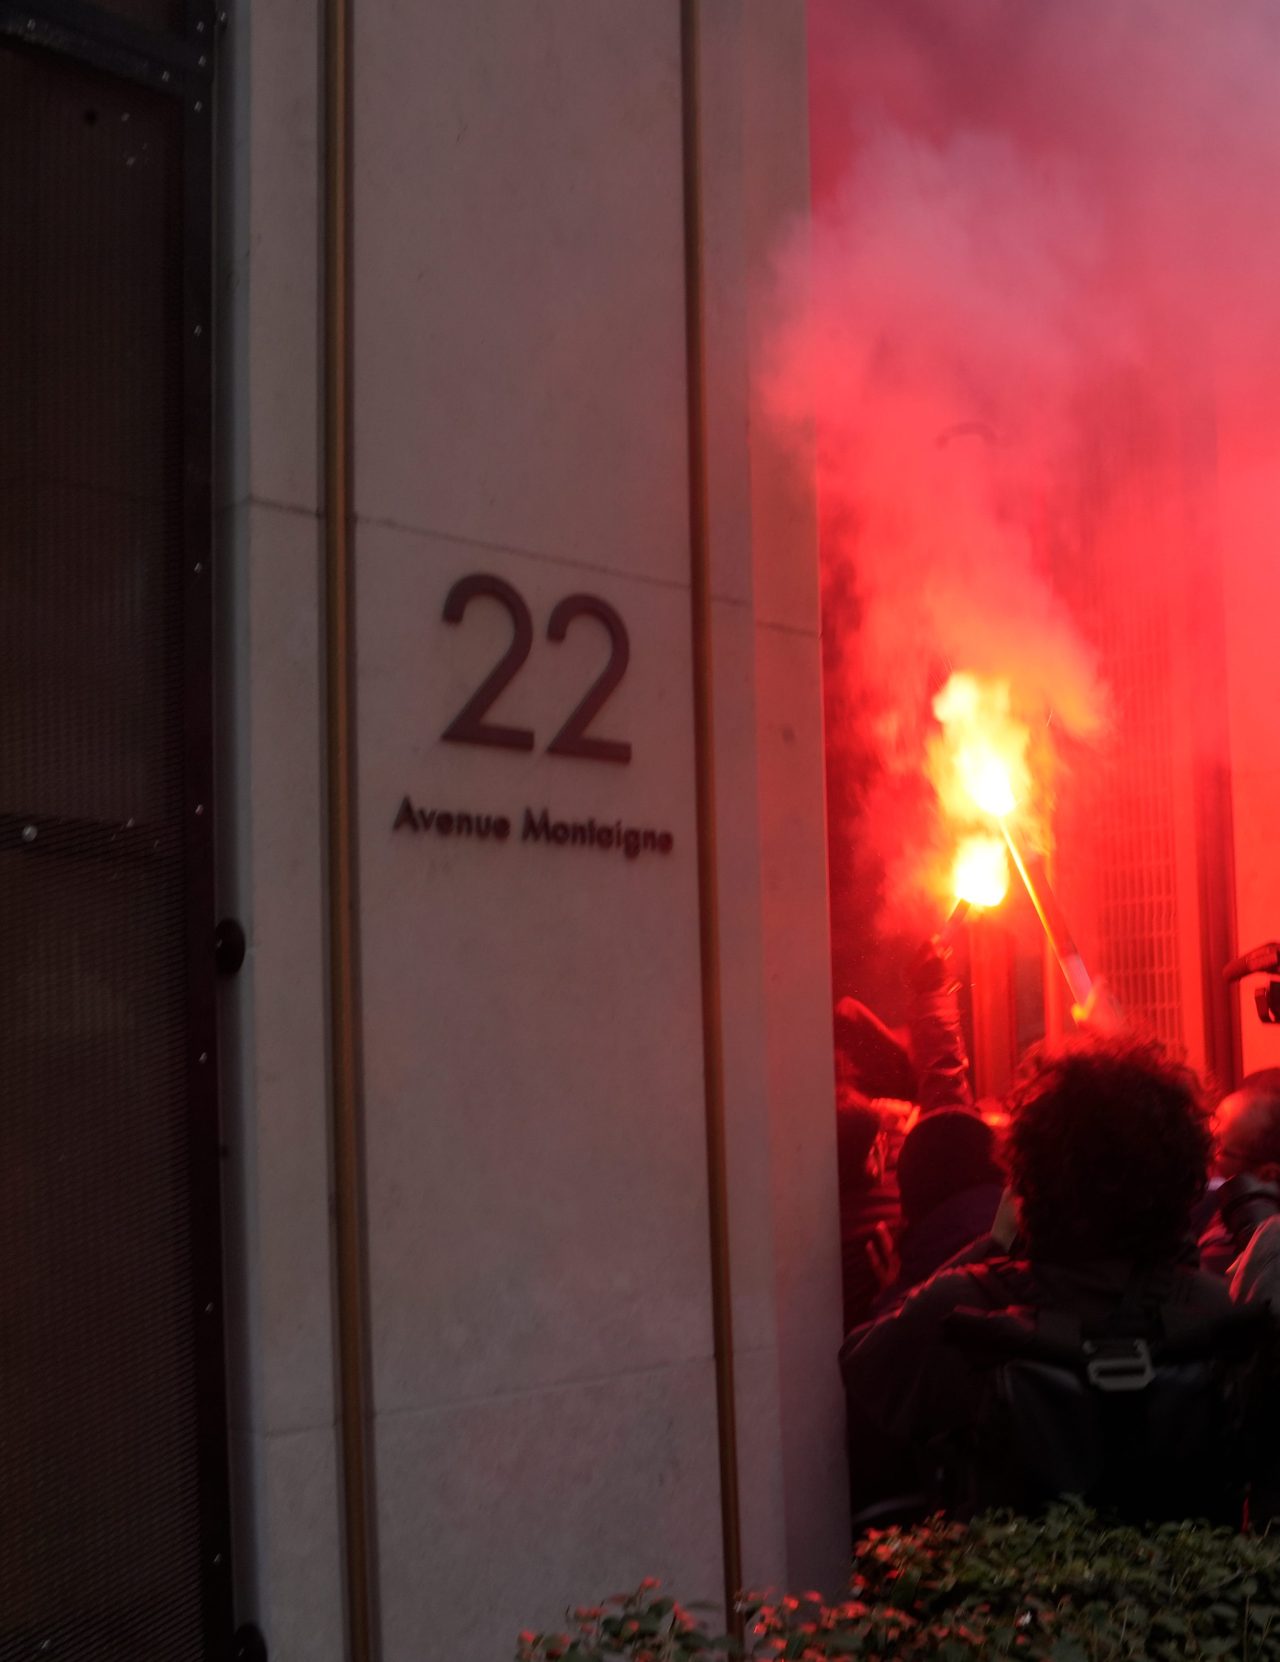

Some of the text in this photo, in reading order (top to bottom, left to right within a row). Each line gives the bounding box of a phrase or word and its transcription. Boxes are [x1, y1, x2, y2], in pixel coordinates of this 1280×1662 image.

[441, 573, 632, 766] 22
[394, 795, 673, 860] Avenue Montaigne
